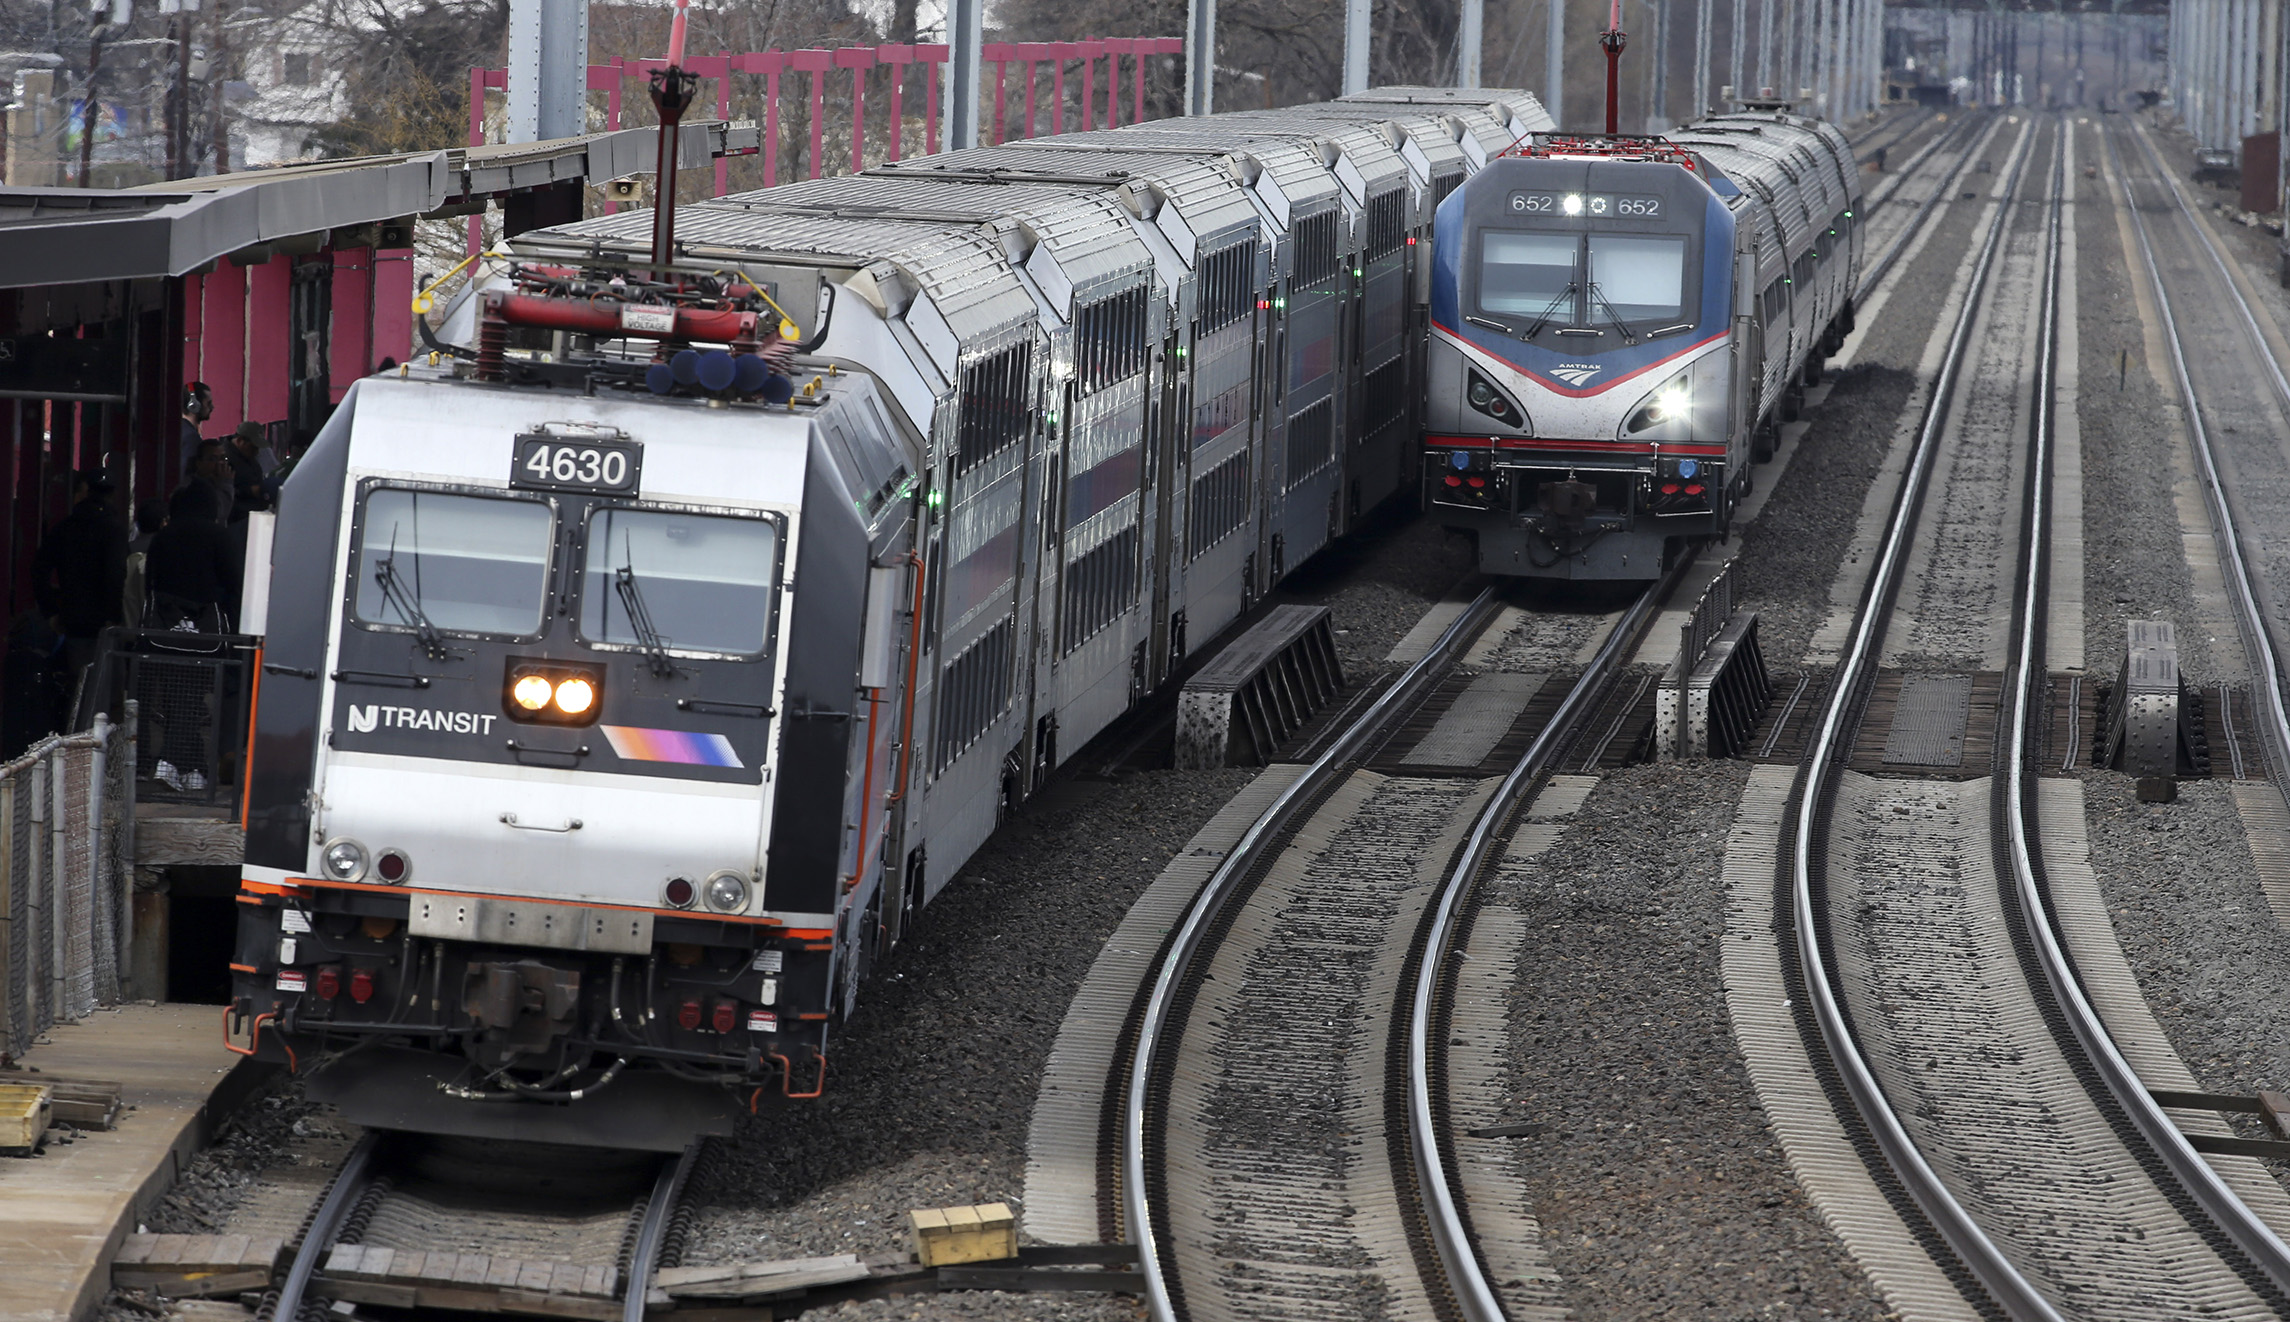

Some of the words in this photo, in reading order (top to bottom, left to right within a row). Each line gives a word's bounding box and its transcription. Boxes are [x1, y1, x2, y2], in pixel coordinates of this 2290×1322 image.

[1512, 195, 1553, 212] 652
[1618, 198, 1660, 216] 652
[628, 321, 668, 331] VOLTAGE
[637, 314, 660, 322] HIGH
[526, 445, 627, 485] 4630
[347, 704, 380, 733] NJ
[381, 706, 497, 736] TRANSIT
